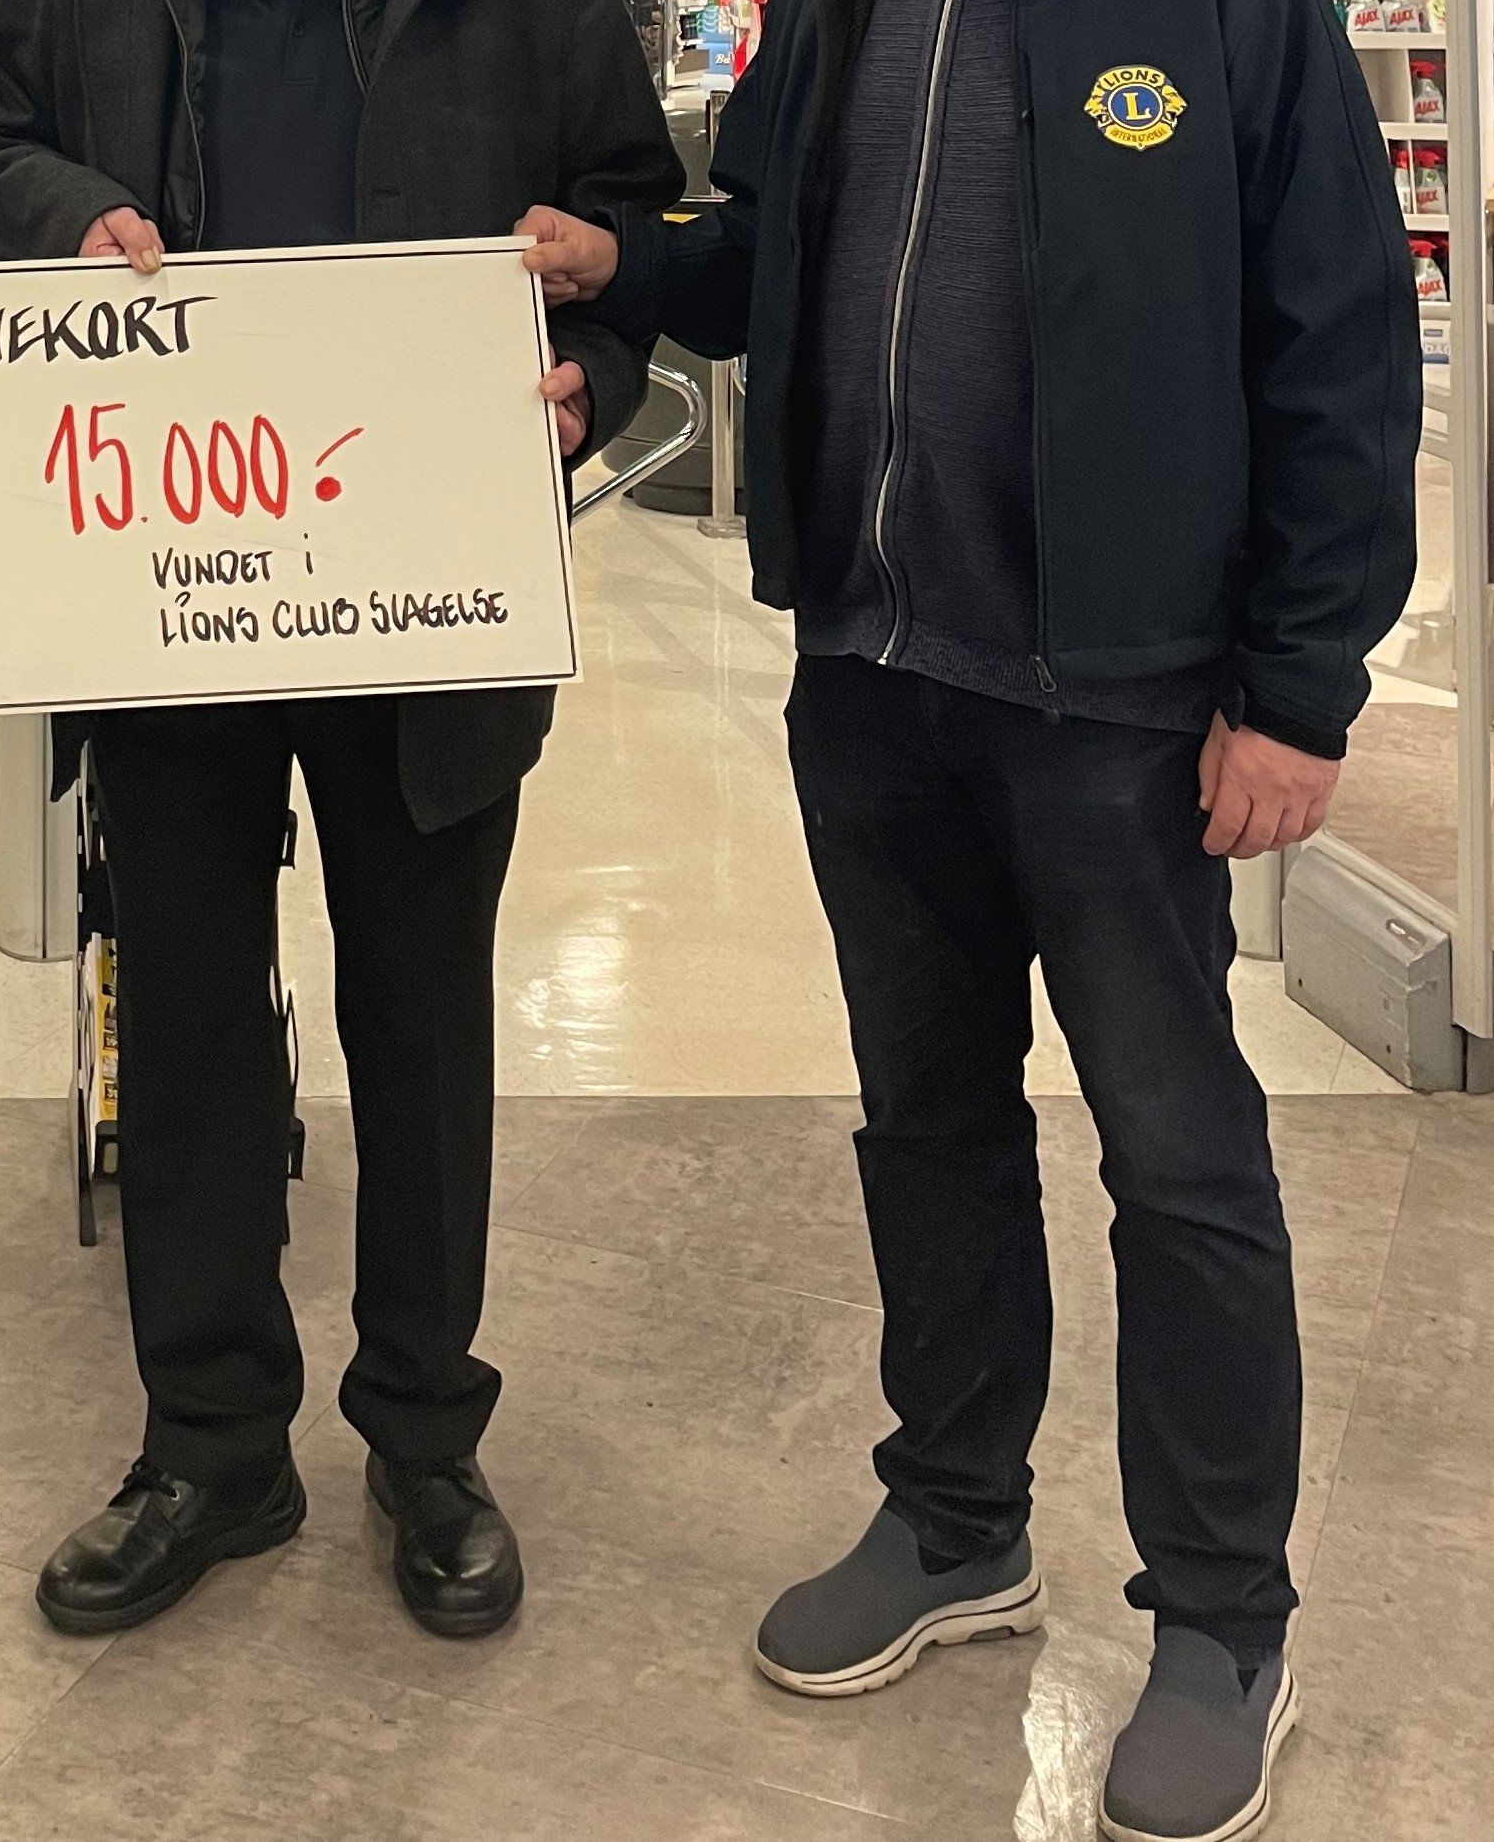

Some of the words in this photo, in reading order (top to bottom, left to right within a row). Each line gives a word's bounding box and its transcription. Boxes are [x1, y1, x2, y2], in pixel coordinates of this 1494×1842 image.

[1355, 9, 1379, 26] AJAX
[1389, 9, 1414, 26] AJAX
[1103, 69, 1161, 88] LIONS
[1122, 92, 1152, 120] L
[1416, 190, 1438, 205] JAX
[152, 547, 275, 585] VUNDET
[304, 533, 315, 576] i
[273, 598, 360, 638] CLUB
[368, 589, 509, 635] SLAGELSE
